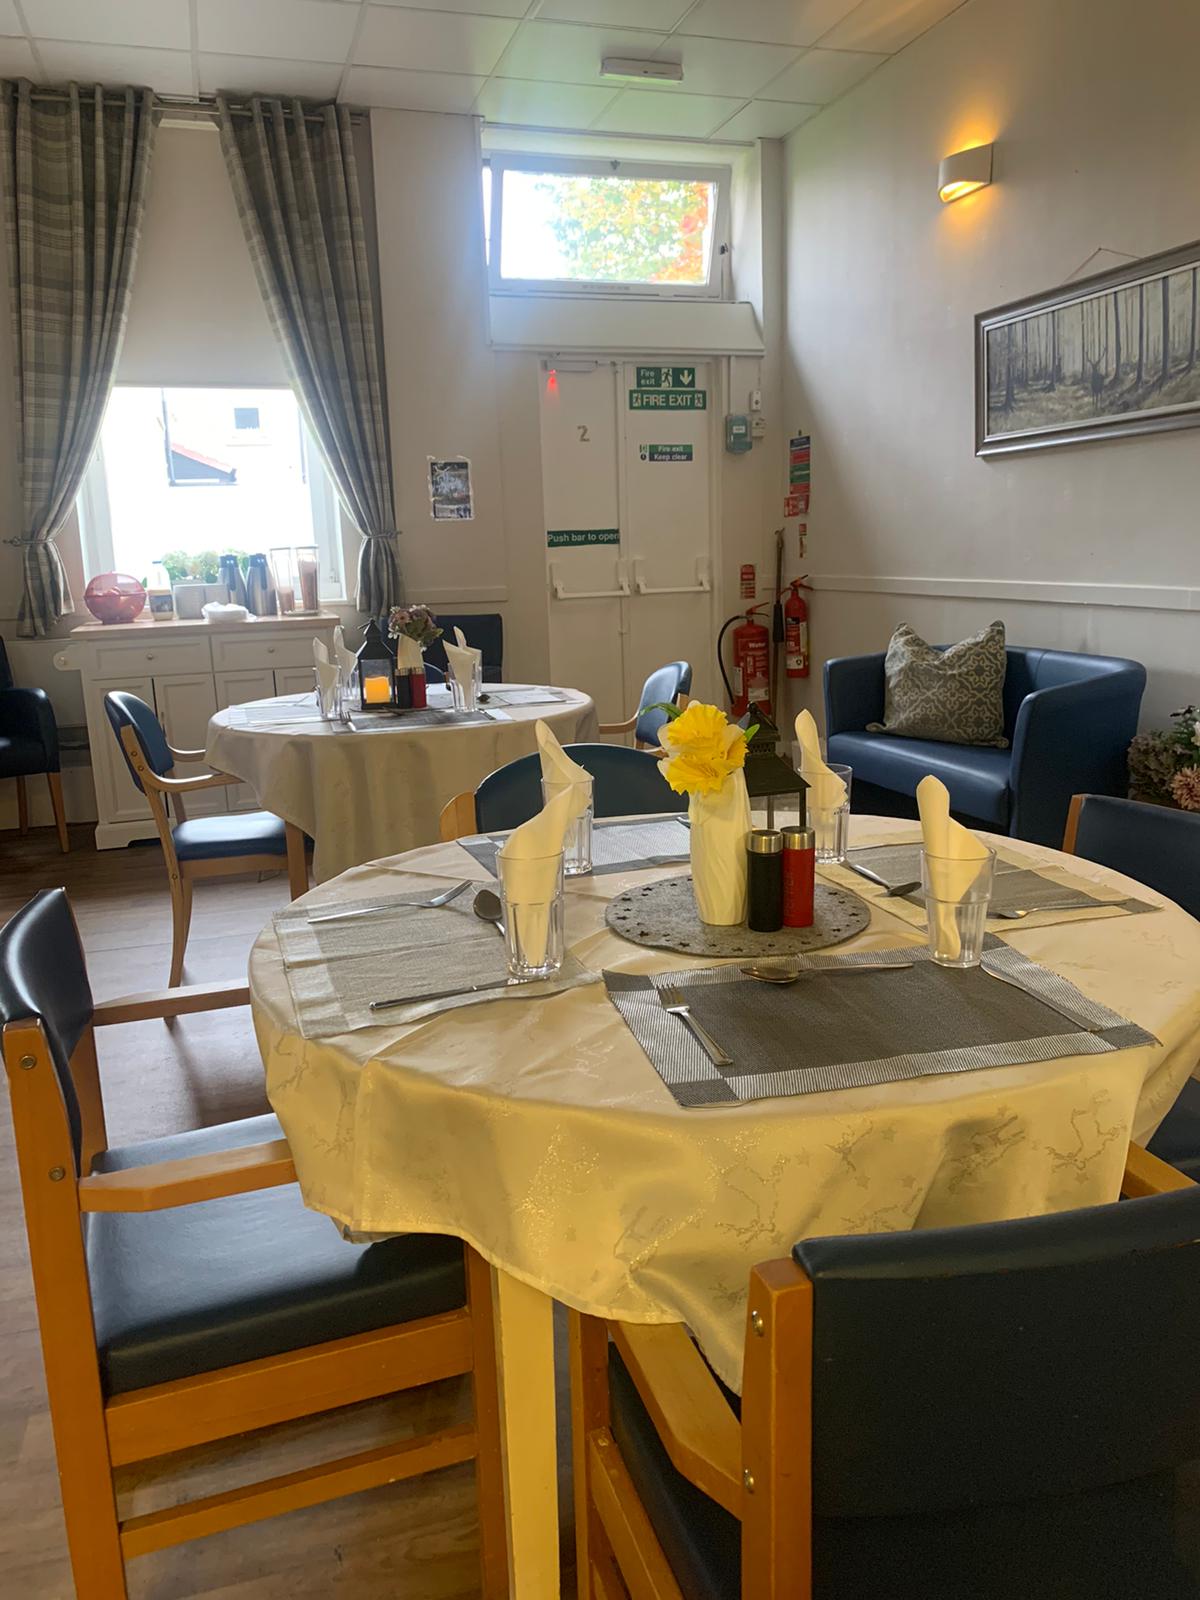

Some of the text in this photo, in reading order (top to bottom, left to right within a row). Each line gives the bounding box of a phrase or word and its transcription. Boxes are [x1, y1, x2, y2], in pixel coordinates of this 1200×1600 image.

[640, 368, 655, 377] Fire
[643, 394, 692, 406] FIRE EXIT
[577, 425, 590, 442] 2
[548, 534, 569, 543] Push
[572, 533, 585, 541] bar
[588, 533, 597, 541] to
